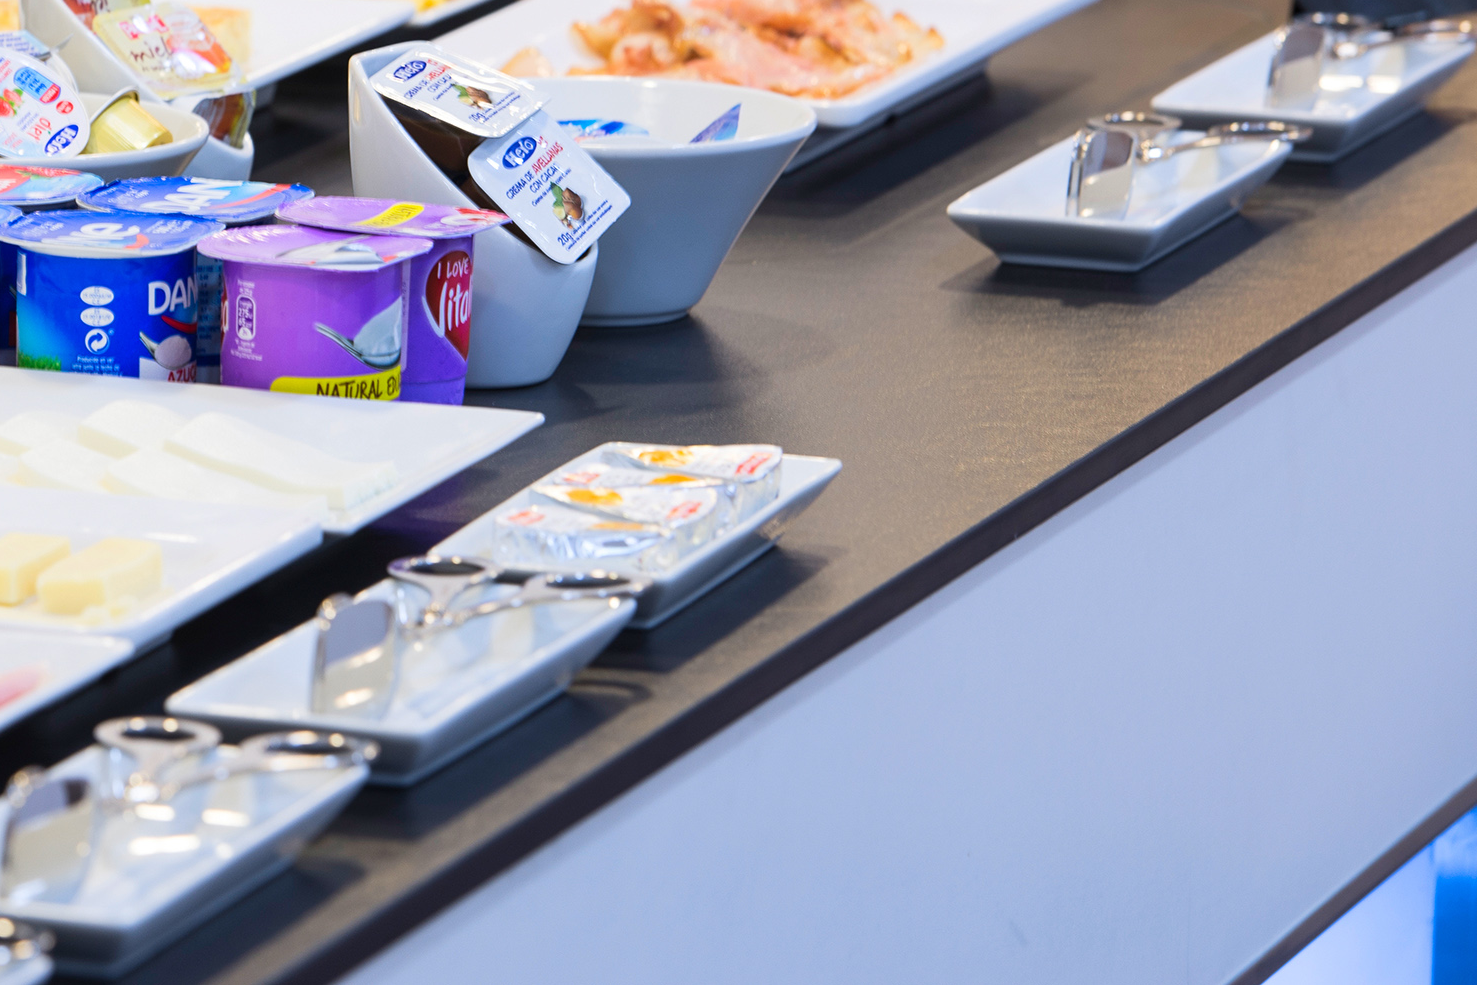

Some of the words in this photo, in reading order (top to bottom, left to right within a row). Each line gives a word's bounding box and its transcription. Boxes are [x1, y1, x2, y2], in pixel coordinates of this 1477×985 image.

[503, 137, 535, 167] Hero
[505, 179, 528, 200] CREMA
[525, 170, 535, 185] DE
[531, 142, 564, 174] AVELLANAS
[529, 179, 542, 194] CON
[557, 230, 574, 247] 20g
[437, 262, 441, 279] I
[446, 257, 469, 279] LOVE
[316, 378, 383, 400] NATURAL
